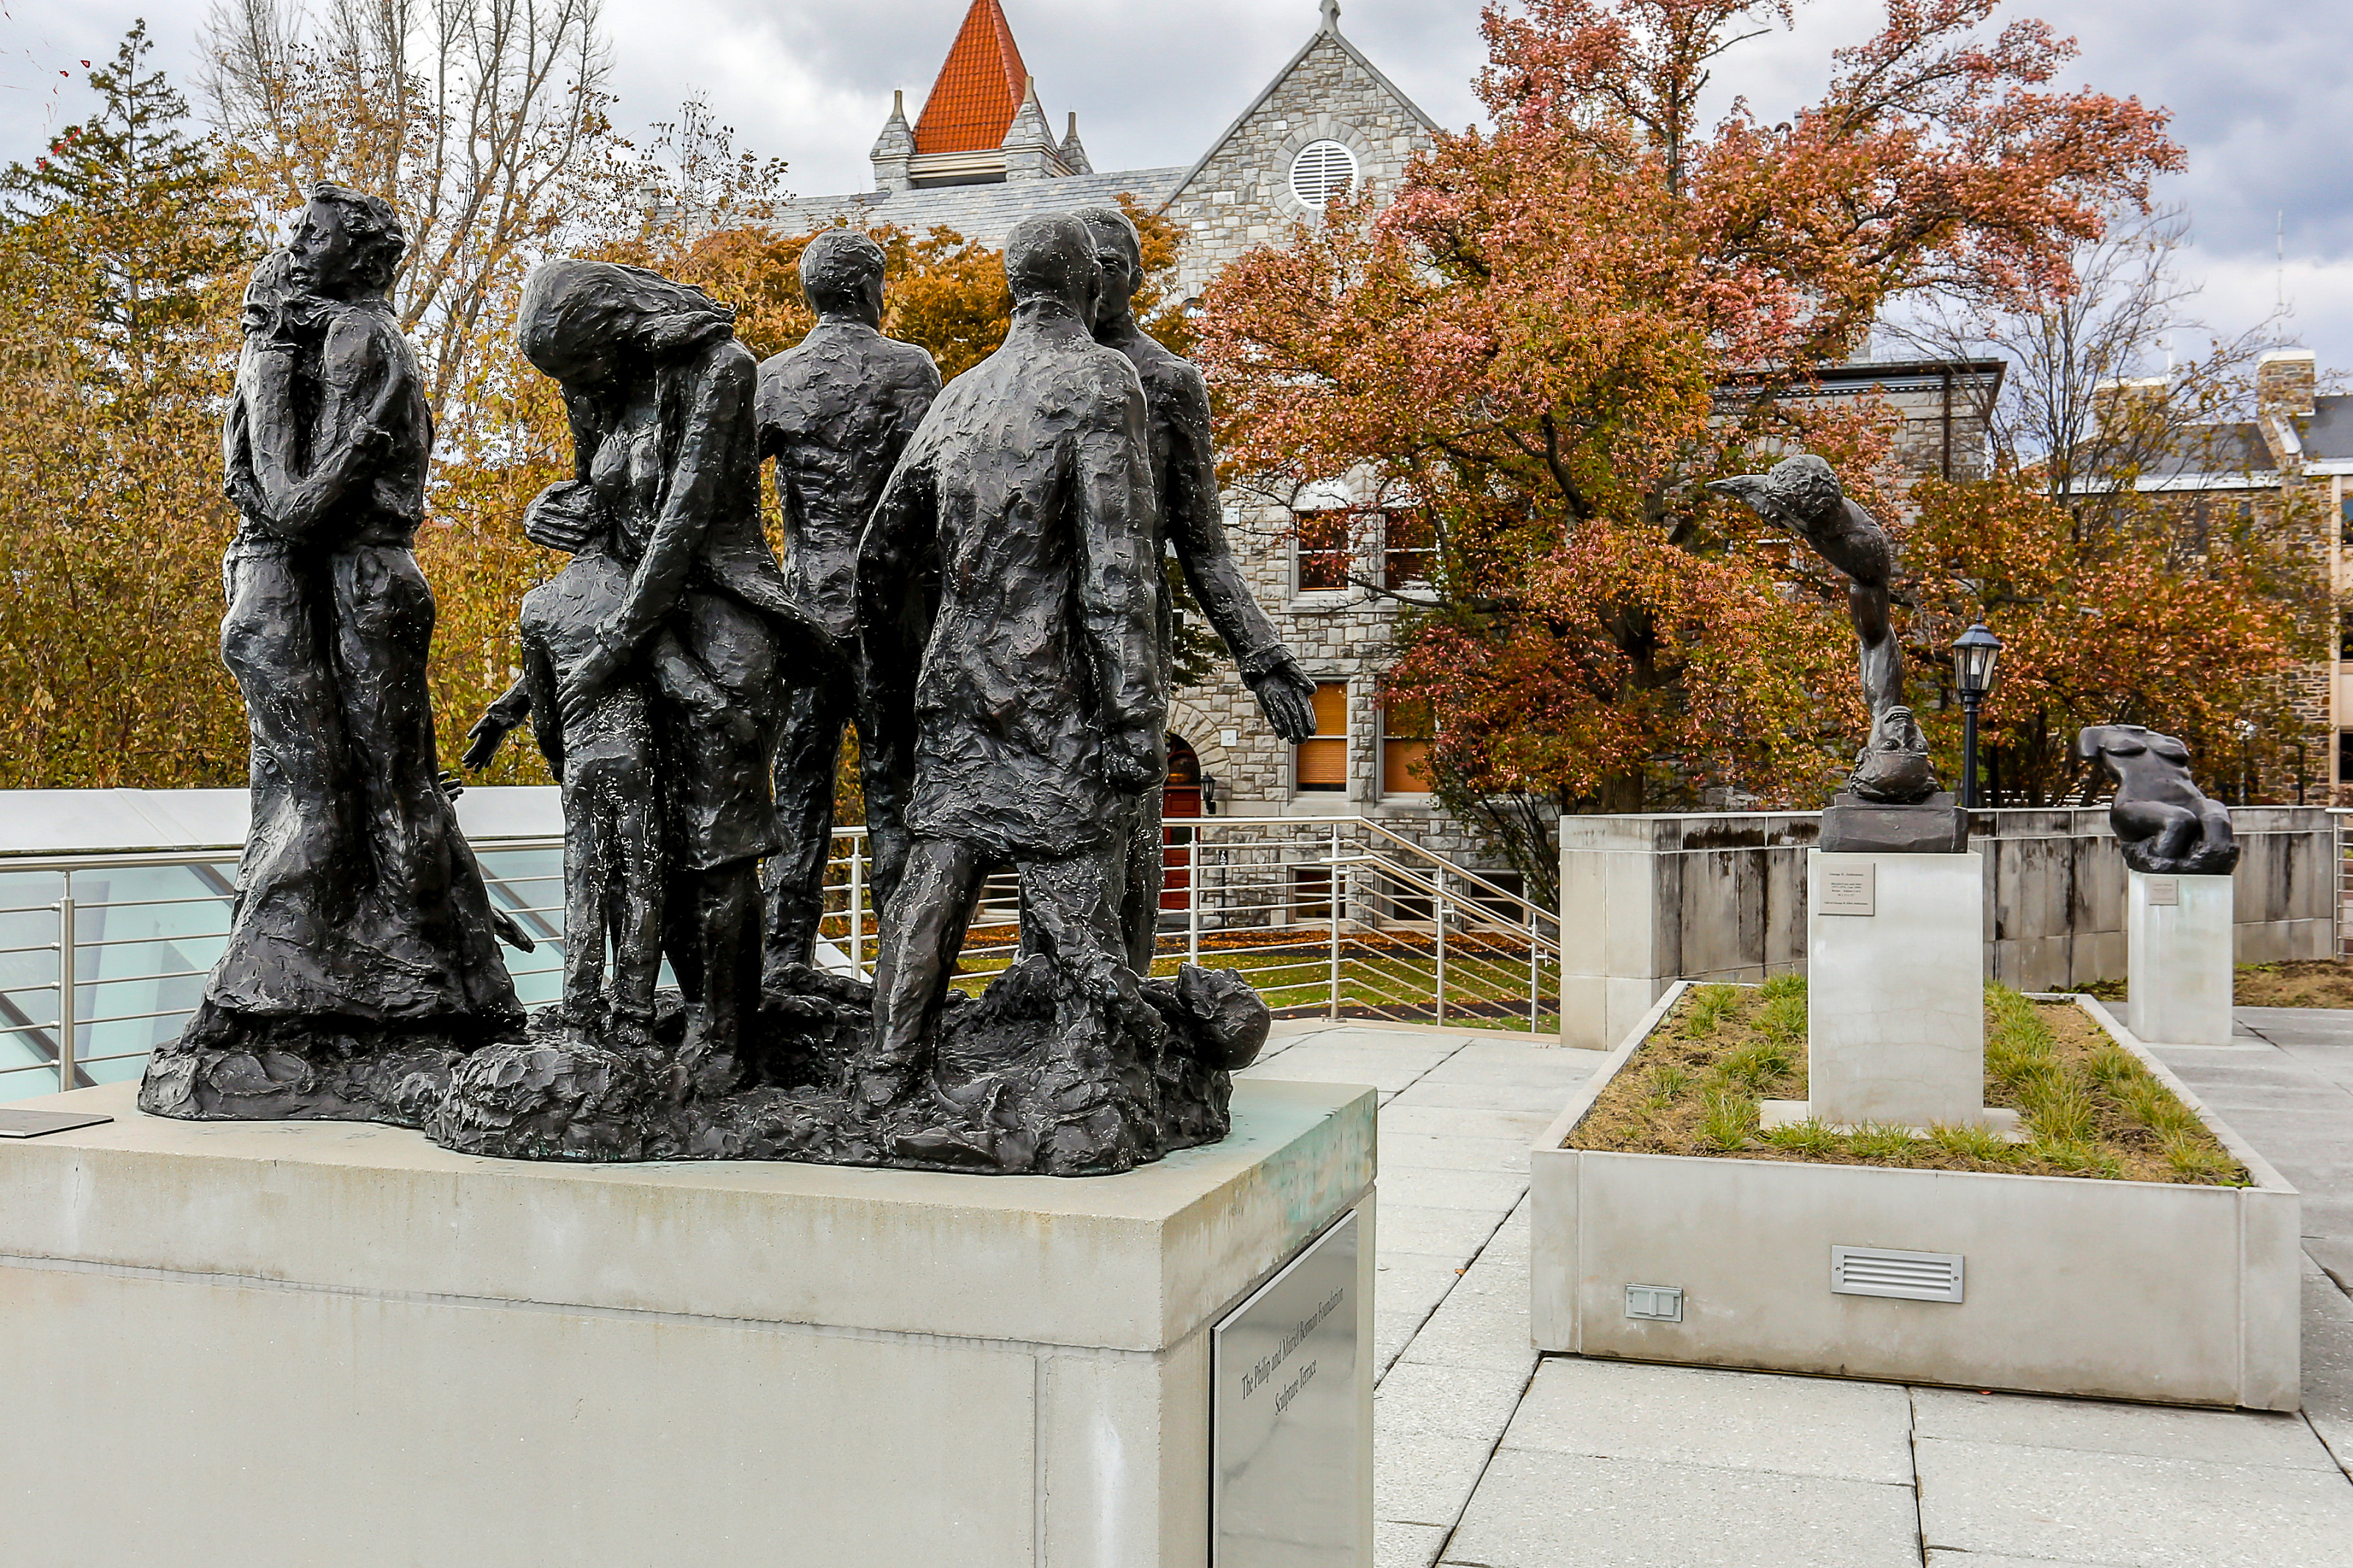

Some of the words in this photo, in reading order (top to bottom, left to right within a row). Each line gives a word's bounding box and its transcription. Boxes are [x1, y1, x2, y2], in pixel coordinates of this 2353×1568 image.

[1242, 1372, 1253, 1400] The
[1254, 1356, 1271, 1388] Philip
[1271, 1341, 1281, 1371] and
[1282, 1323, 1299, 1361] Muriel
[1300, 1313, 1318, 1342] Berman
[1318, 1286, 1343, 1323] Foundation
[1275, 1379, 1299, 1416] Sculpture
[1299, 1359, 1316, 1389] Terrace
